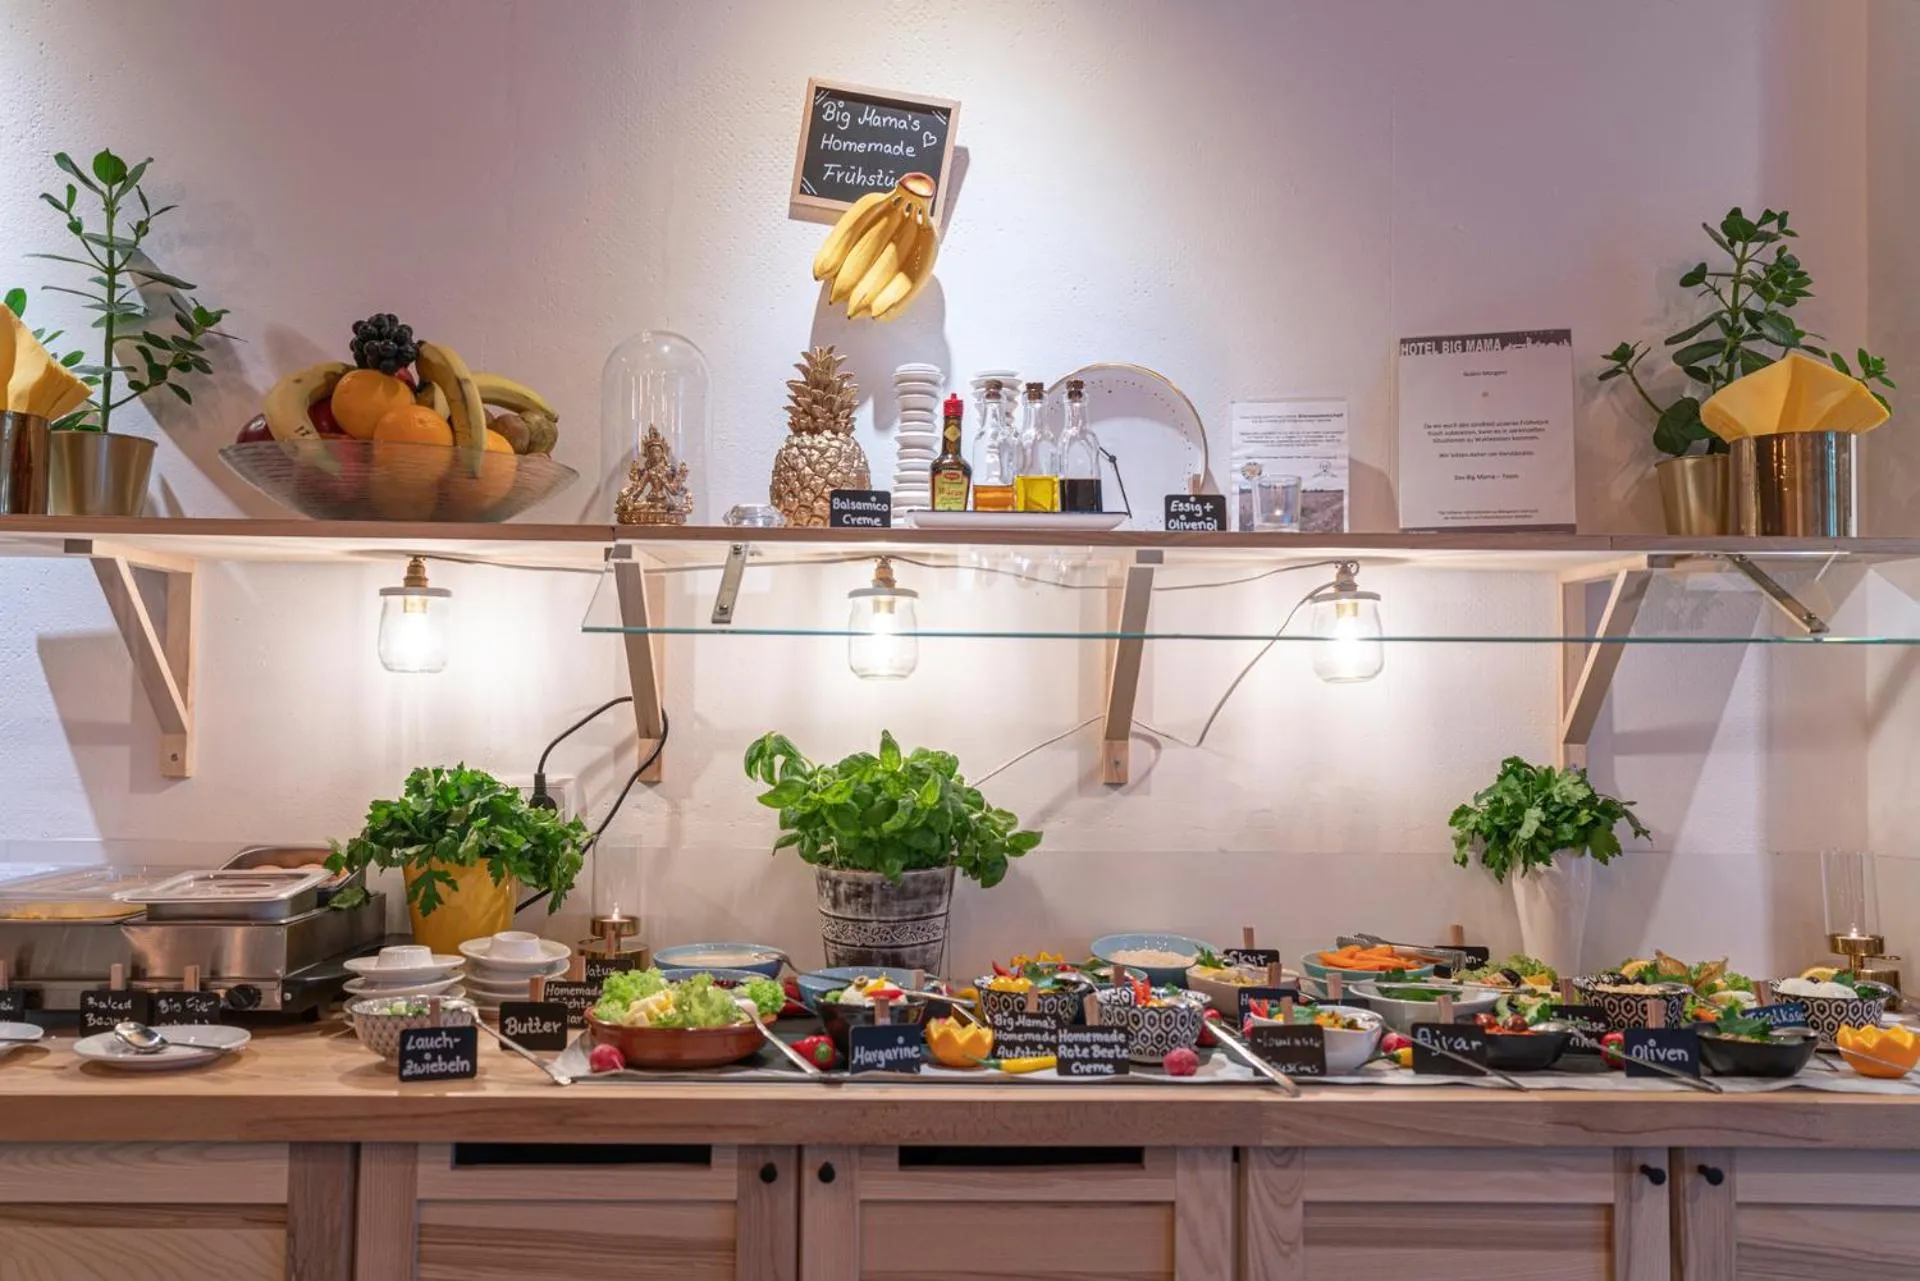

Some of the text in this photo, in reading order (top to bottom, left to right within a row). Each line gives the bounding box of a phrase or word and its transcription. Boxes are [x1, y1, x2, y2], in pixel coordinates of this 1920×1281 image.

[822, 100, 921, 132] Big Mama's
[820, 133, 917, 157] Homemade
[1400, 337, 1501, 356] HOTEL BIG MAMA
[832, 496, 889, 512] Balsamico
[1170, 496, 1203, 517] Essig
[842, 513, 882, 526] Creme
[1168, 515, 1218, 531] Olivenöl
[504, 1016, 562, 1036] Butter
[993, 1011, 1015, 1031] Big
[406, 1031, 462, 1051] Lauch-
[995, 1029, 1057, 1043] Homemade
[1058, 1028, 1126, 1043] Homemade
[852, 1035, 921, 1068] Margarine
[1058, 1044, 1129, 1058] Rote Beete
[1632, 1038, 1689, 1062] Oliven
[402, 1052, 471, 1077] Zwiebeln
[1071, 1061, 1115, 1074] Creme
